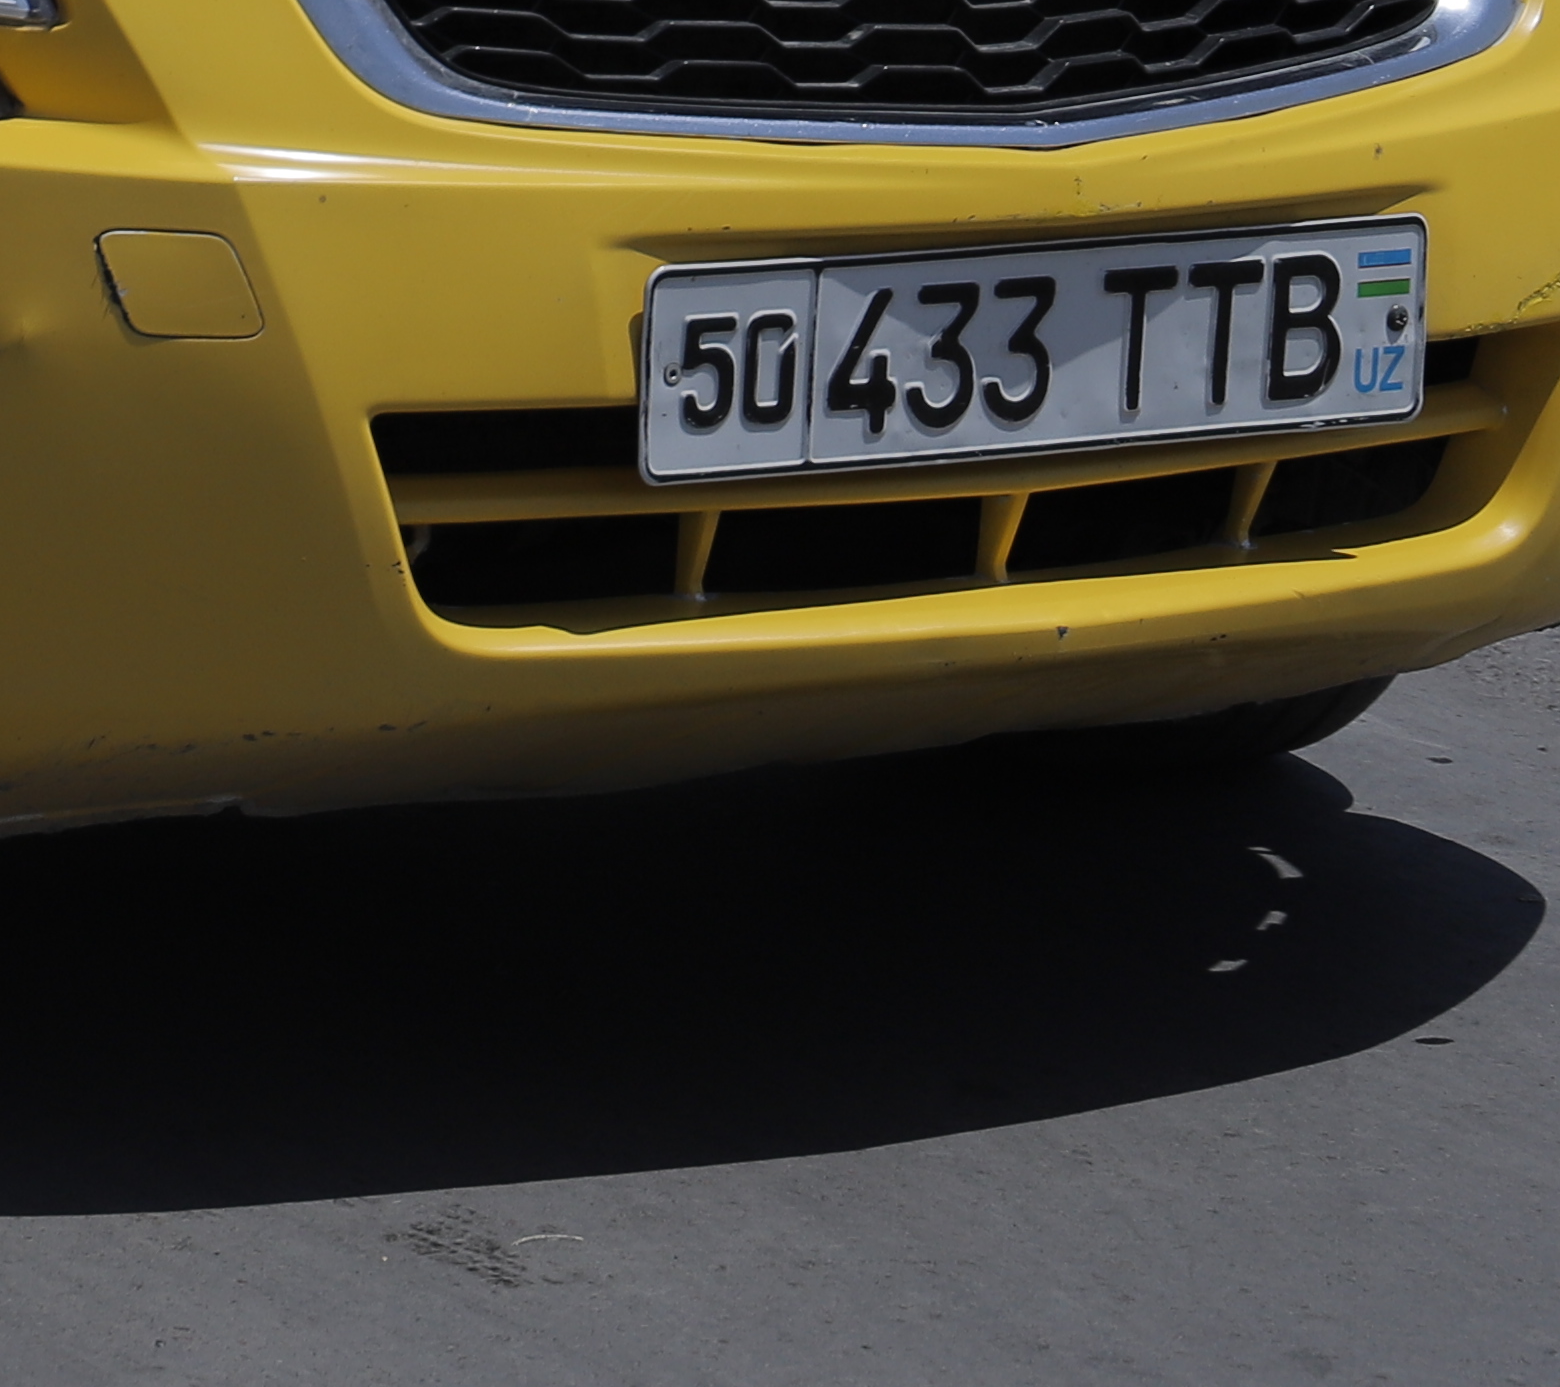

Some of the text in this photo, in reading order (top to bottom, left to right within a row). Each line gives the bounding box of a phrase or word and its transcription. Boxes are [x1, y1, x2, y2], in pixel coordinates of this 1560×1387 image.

[681, 250, 1343, 434] 50 433 TTB
[1353, 344, 1406, 394] UZ
